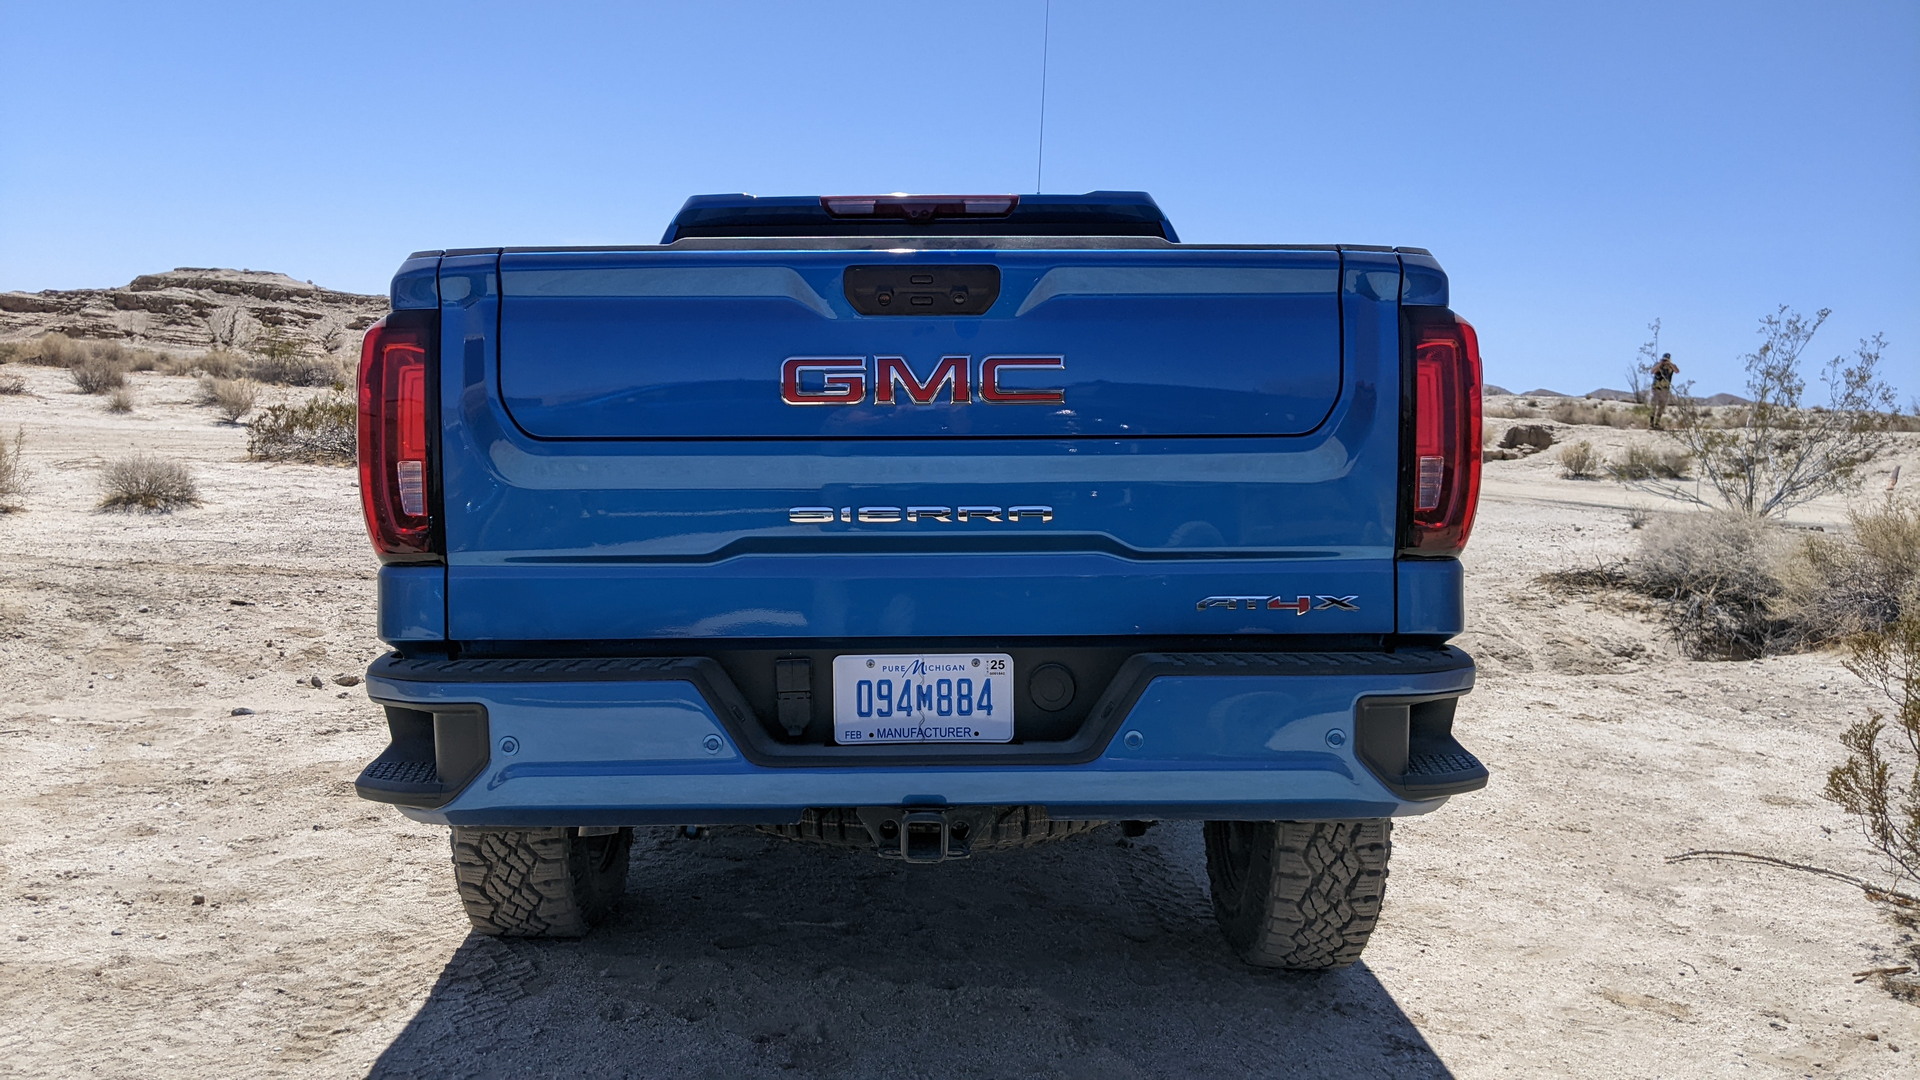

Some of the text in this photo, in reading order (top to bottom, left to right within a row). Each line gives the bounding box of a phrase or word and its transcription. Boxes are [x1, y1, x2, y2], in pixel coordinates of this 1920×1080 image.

[780, 354, 1065, 405] GMC
[789, 505, 1053, 523] SIERRA
[1196, 595, 1361, 616] AT4X
[882, 659, 965, 678] PURE MICHIGAN
[990, 659, 1006, 670] 25
[856, 678, 993, 717] 094M884
[844, 730, 862, 739] FEB
[876, 727, 971, 739] MANUFACTURER
